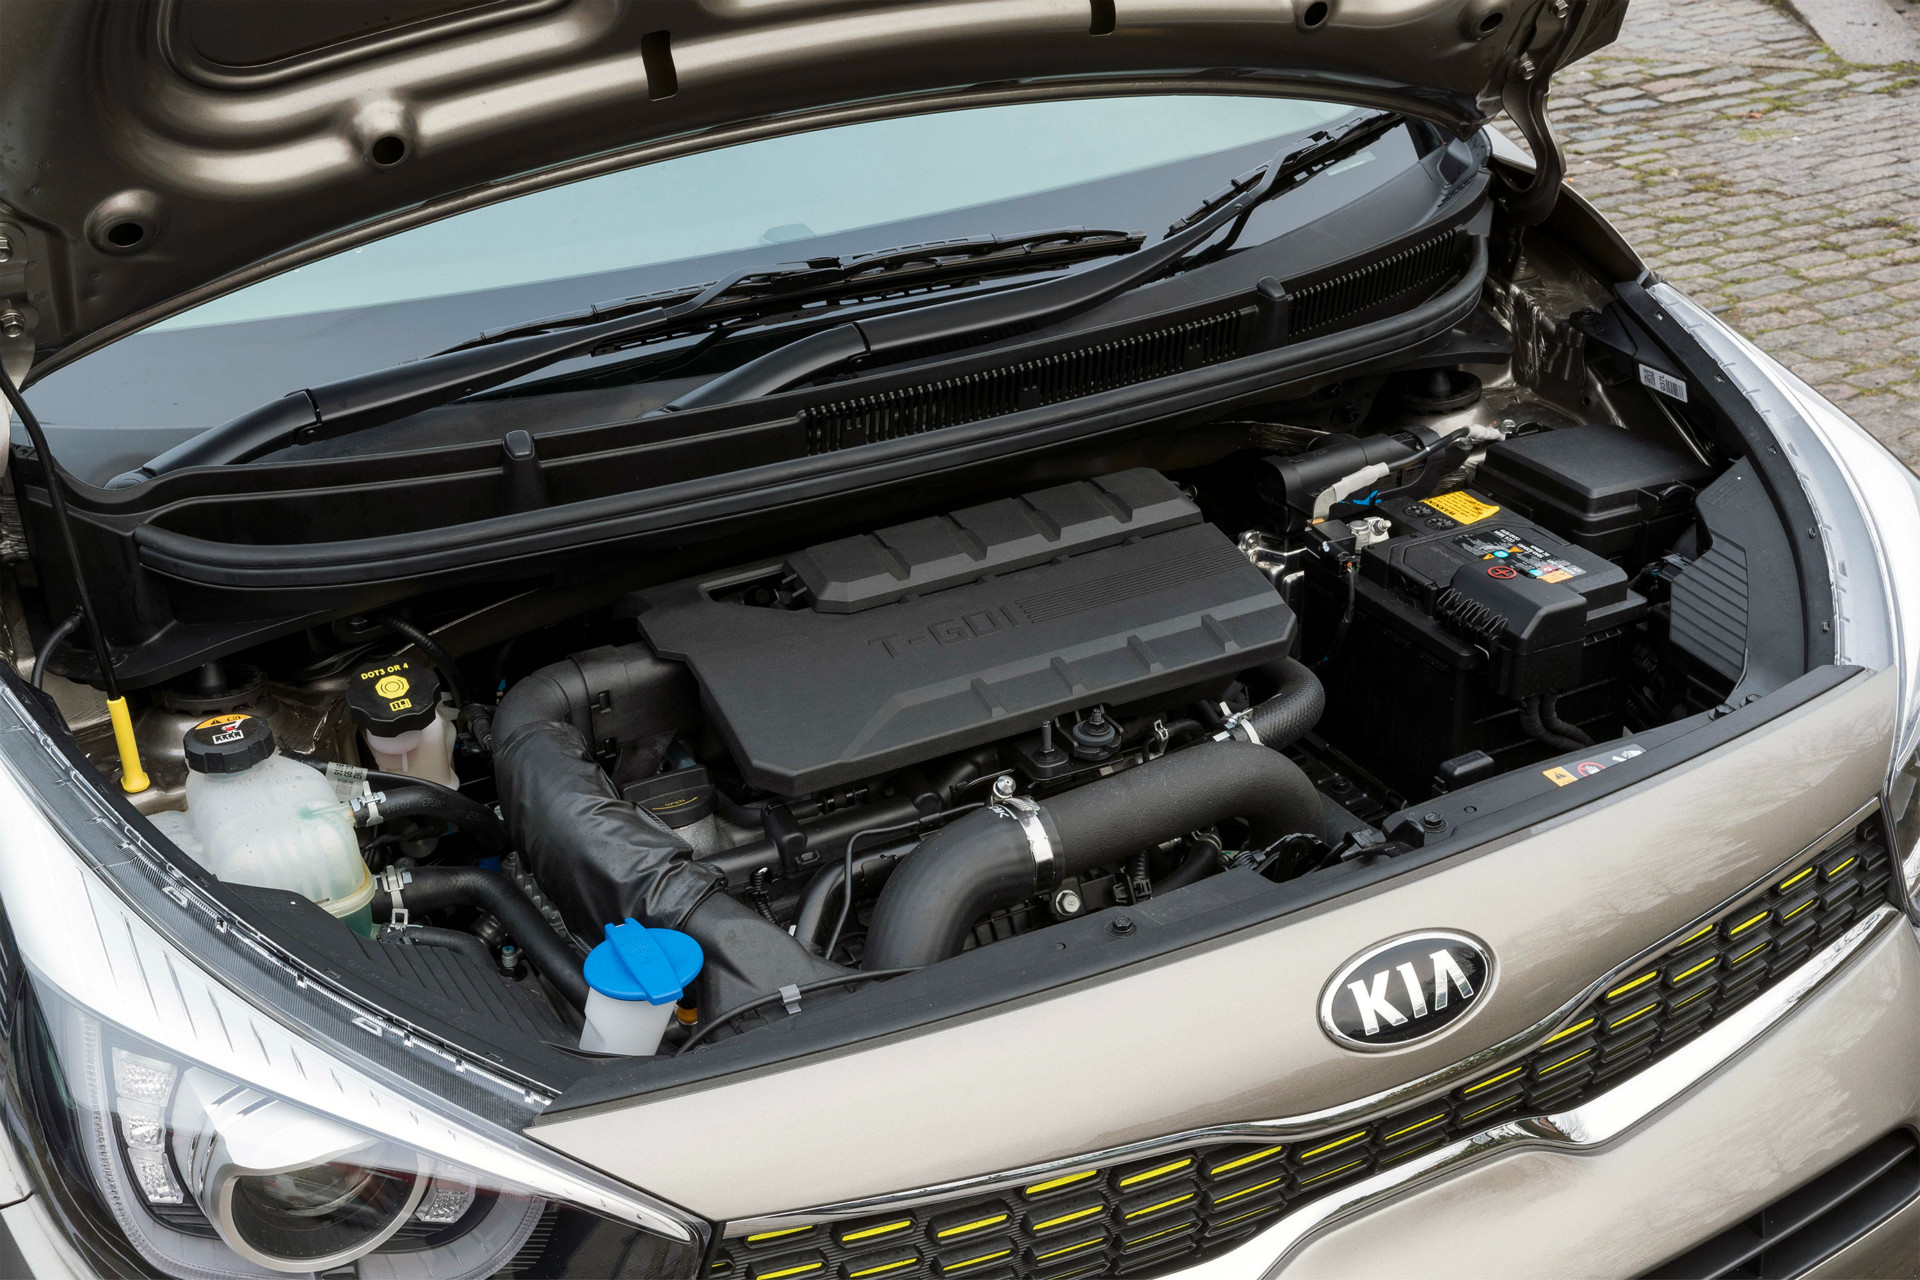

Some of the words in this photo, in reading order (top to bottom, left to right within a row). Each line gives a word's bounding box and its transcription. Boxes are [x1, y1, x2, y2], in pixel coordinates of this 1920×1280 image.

[868, 604, 1023, 660] T-GDI
[361, 668, 386, 680] DOT3
[387, 664, 402, 673] OR
[664, 798, 685, 807] OPEN
[1347, 948, 1475, 1036] KIA
